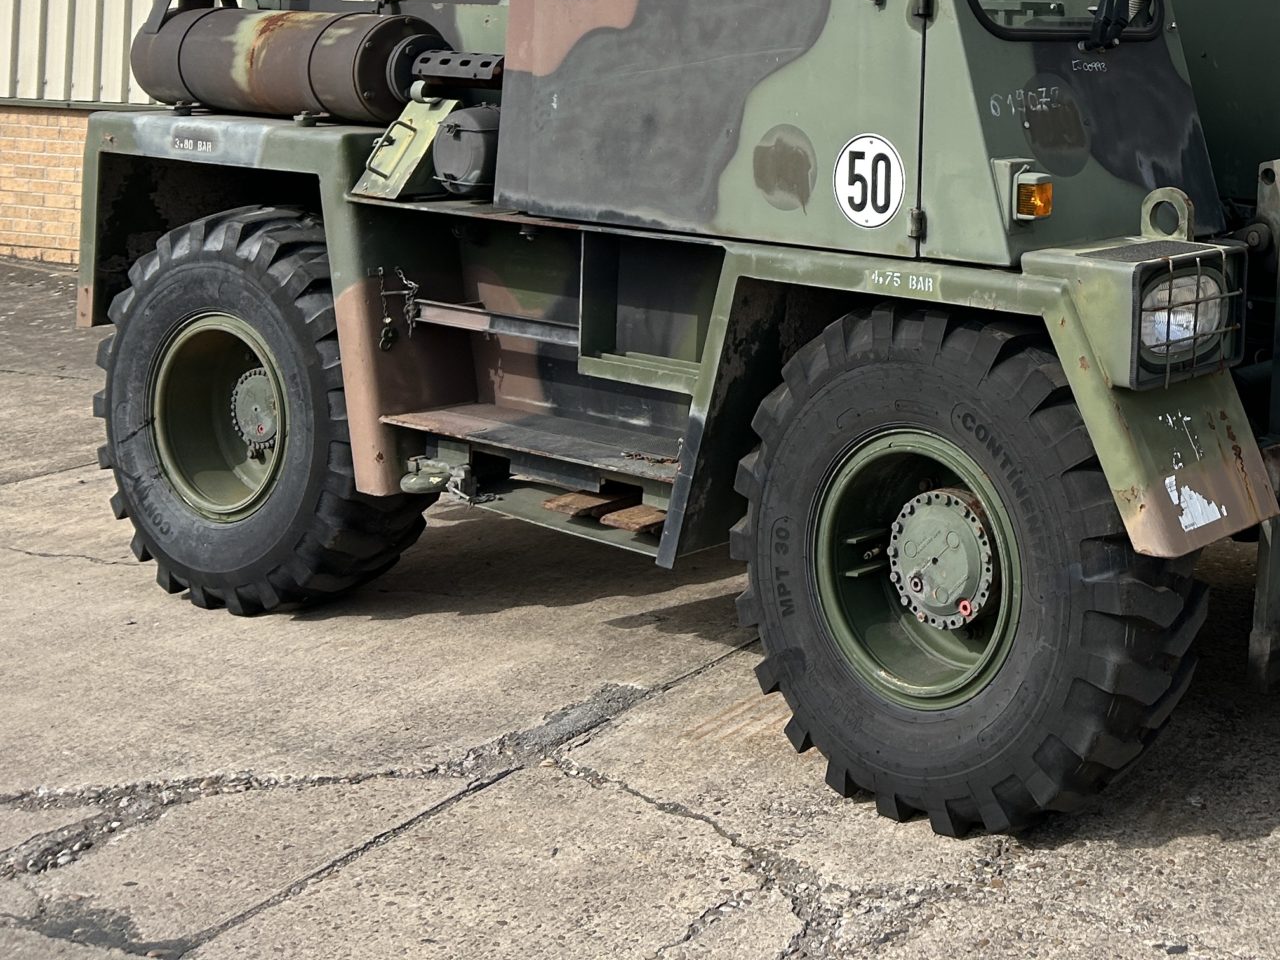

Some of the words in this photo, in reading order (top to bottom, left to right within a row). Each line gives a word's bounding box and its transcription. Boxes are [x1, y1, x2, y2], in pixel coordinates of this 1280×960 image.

[197, 140, 212, 152] BAR
[848, 150, 891, 213] 50
[909, 275, 933, 292] BAR
[775, 526, 791, 557] 30
[775, 566, 796, 619] MPT
